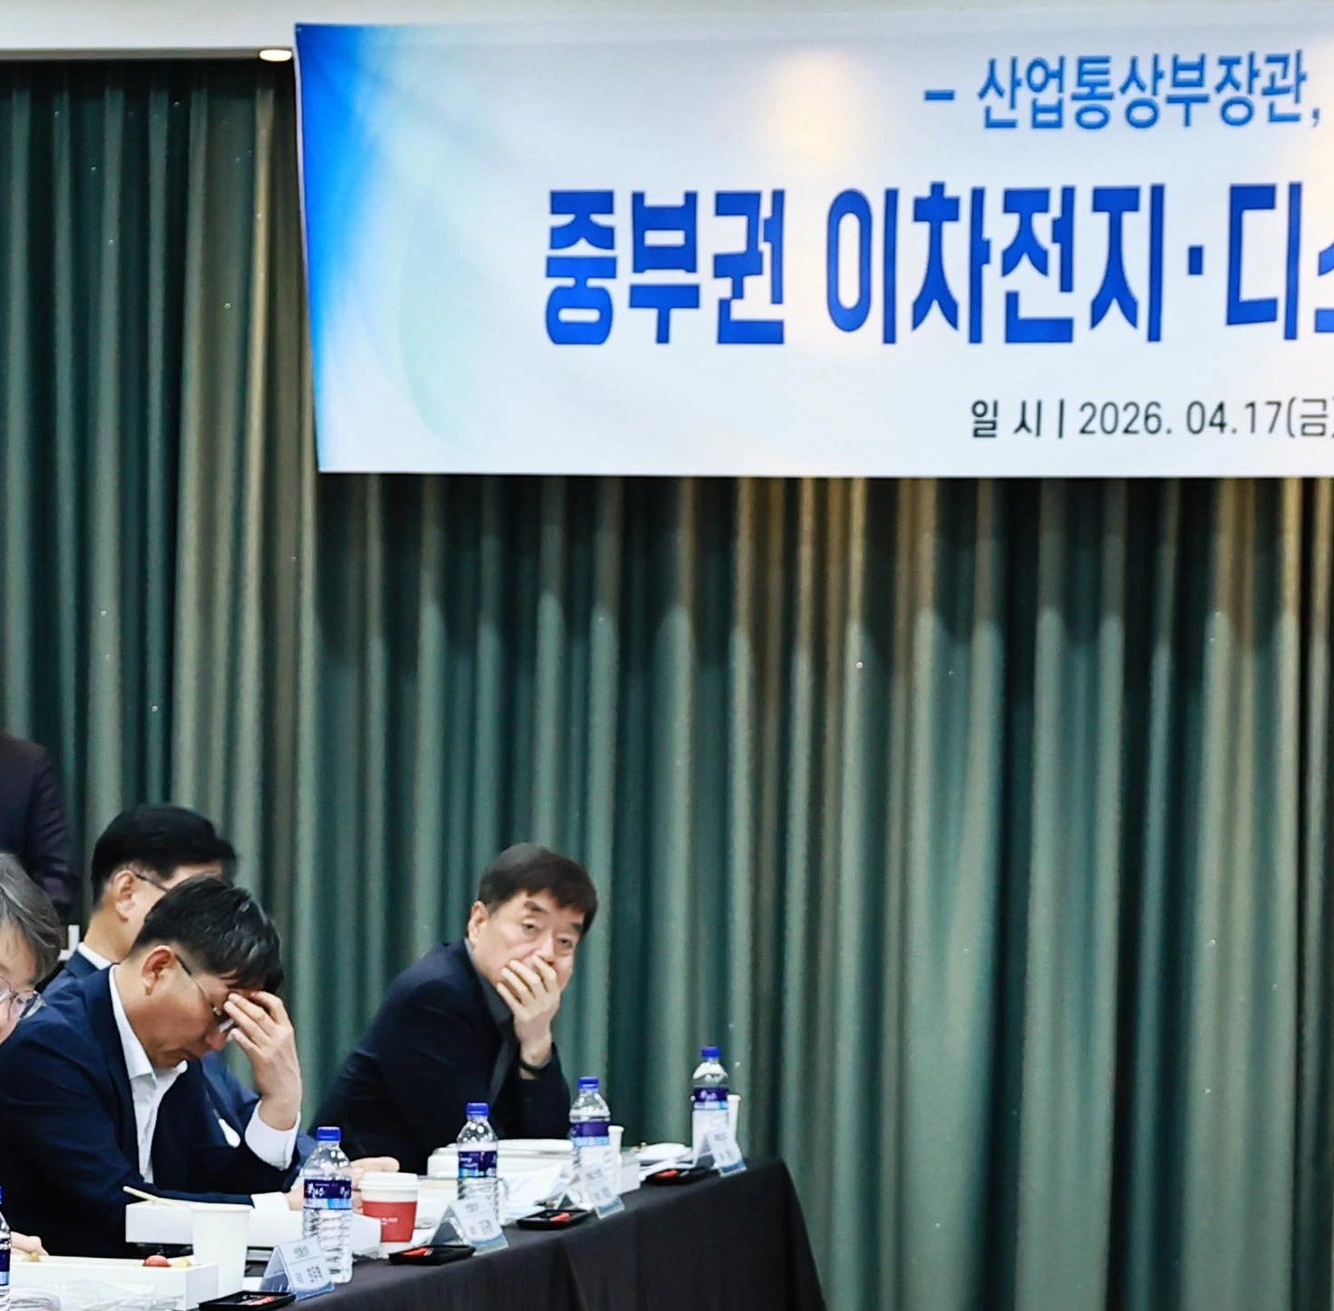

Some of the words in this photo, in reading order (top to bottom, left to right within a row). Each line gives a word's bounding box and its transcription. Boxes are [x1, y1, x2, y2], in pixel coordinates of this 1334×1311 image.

[977, 48, 1322, 130] 산업통상부장관,
[545, 188, 787, 346] 중부권
[1078, 400, 1174, 436] 2026.
